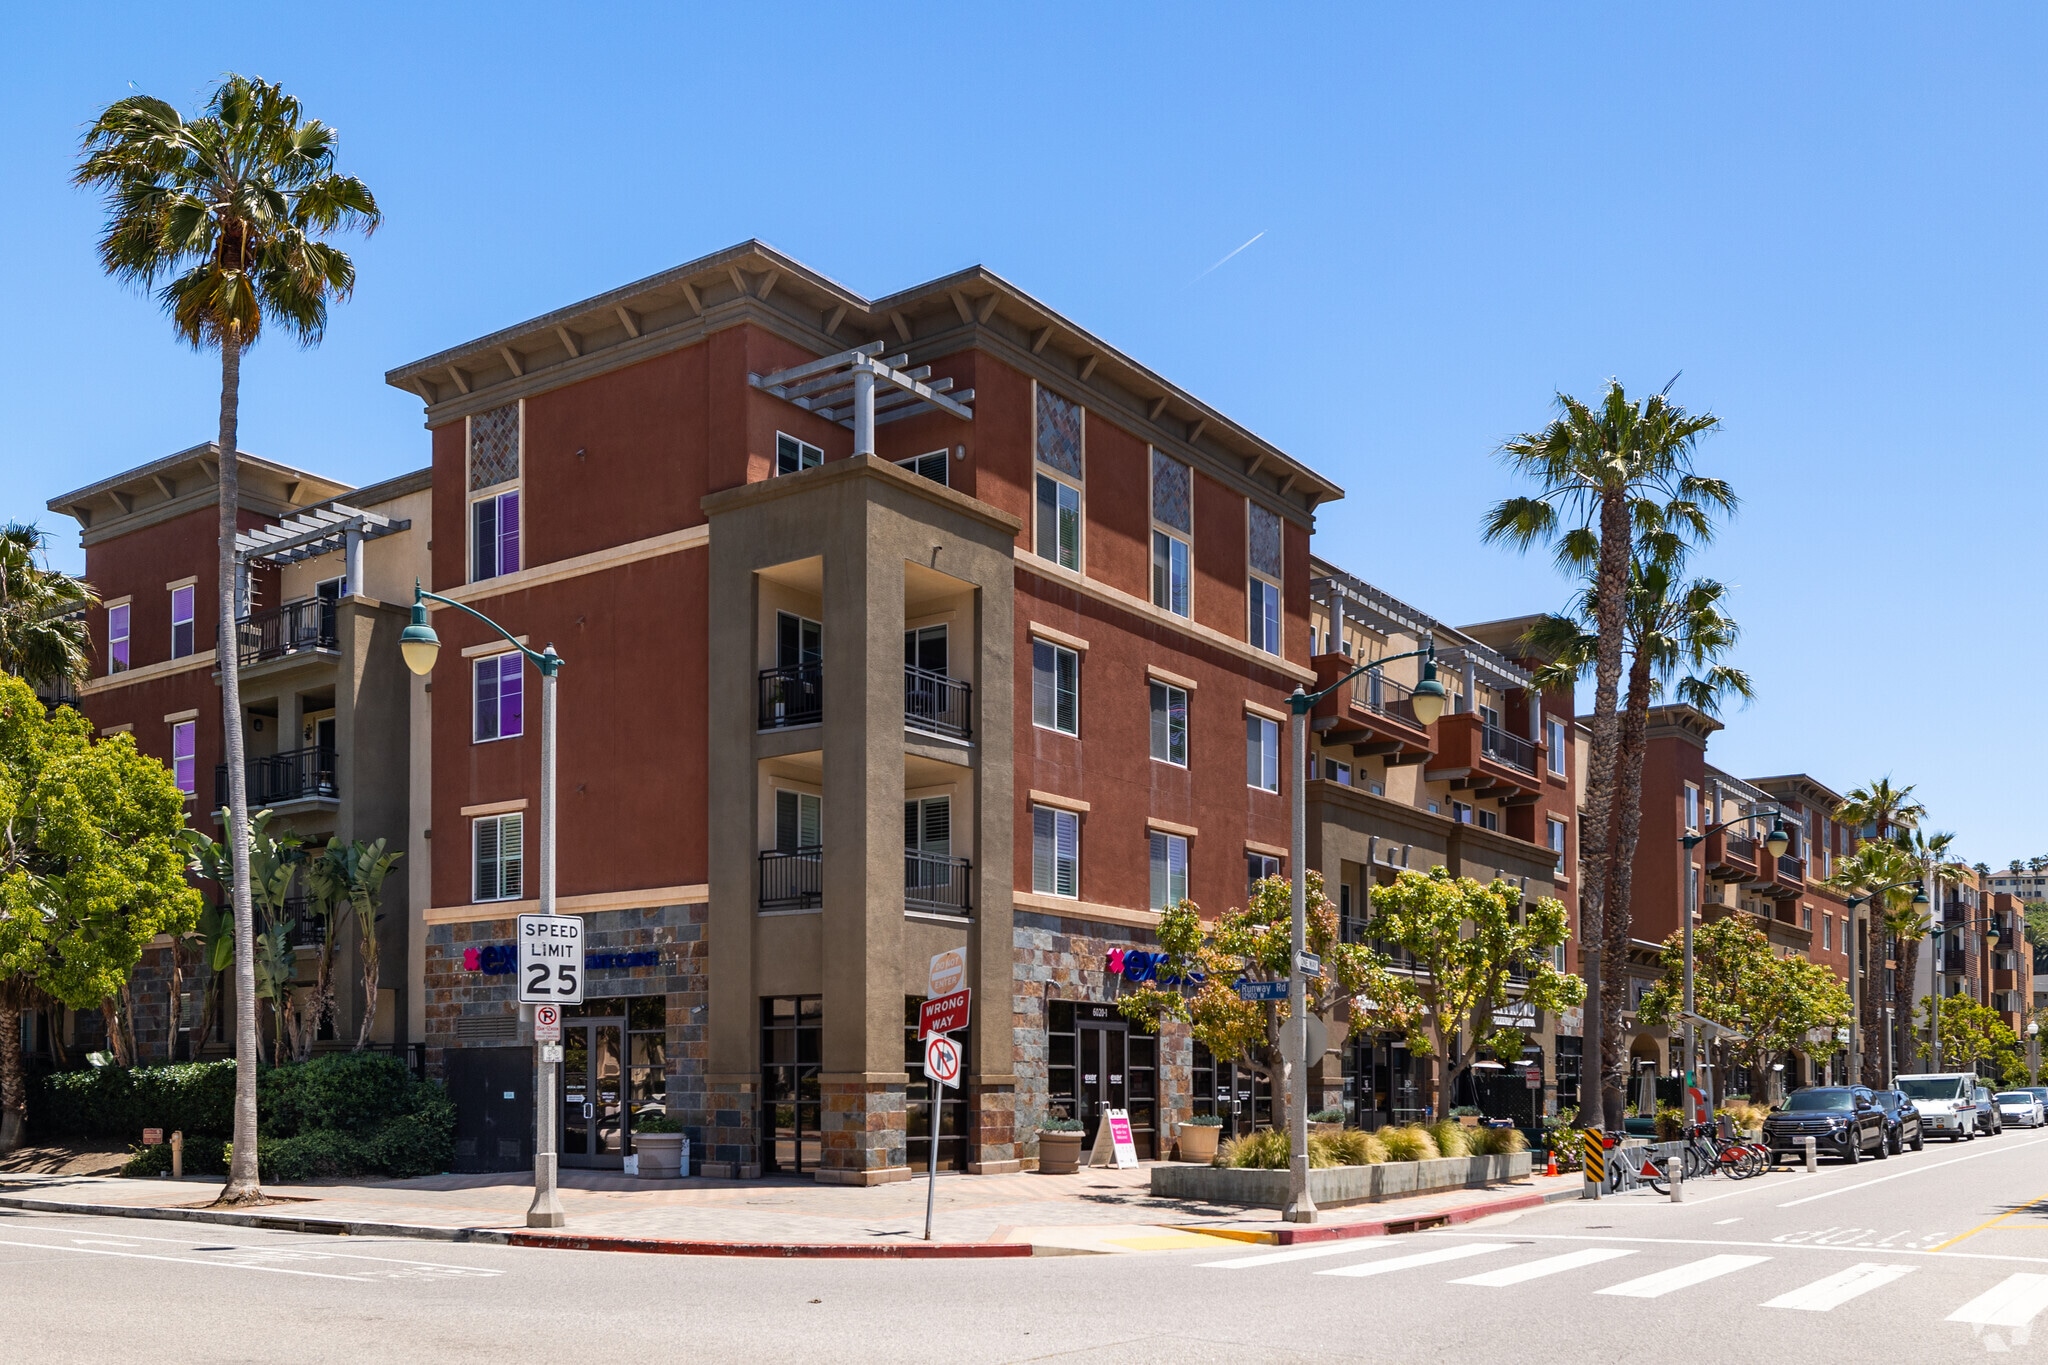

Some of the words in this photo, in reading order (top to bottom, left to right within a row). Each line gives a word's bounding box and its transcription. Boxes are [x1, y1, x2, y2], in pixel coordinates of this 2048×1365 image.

[525, 923, 578, 938] SPEED
[531, 943, 573, 958] LIMIT
[935, 961, 944, 971] DO
[946, 956, 960, 967] NOT
[526, 963, 577, 996] 25
[934, 975, 957, 989] ENTER
[1241, 984, 1271, 995] Runway
[1276, 983, 1287, 992] Rd
[925, 995, 964, 1017] WRONG
[932, 1014, 955, 1030] WAY
